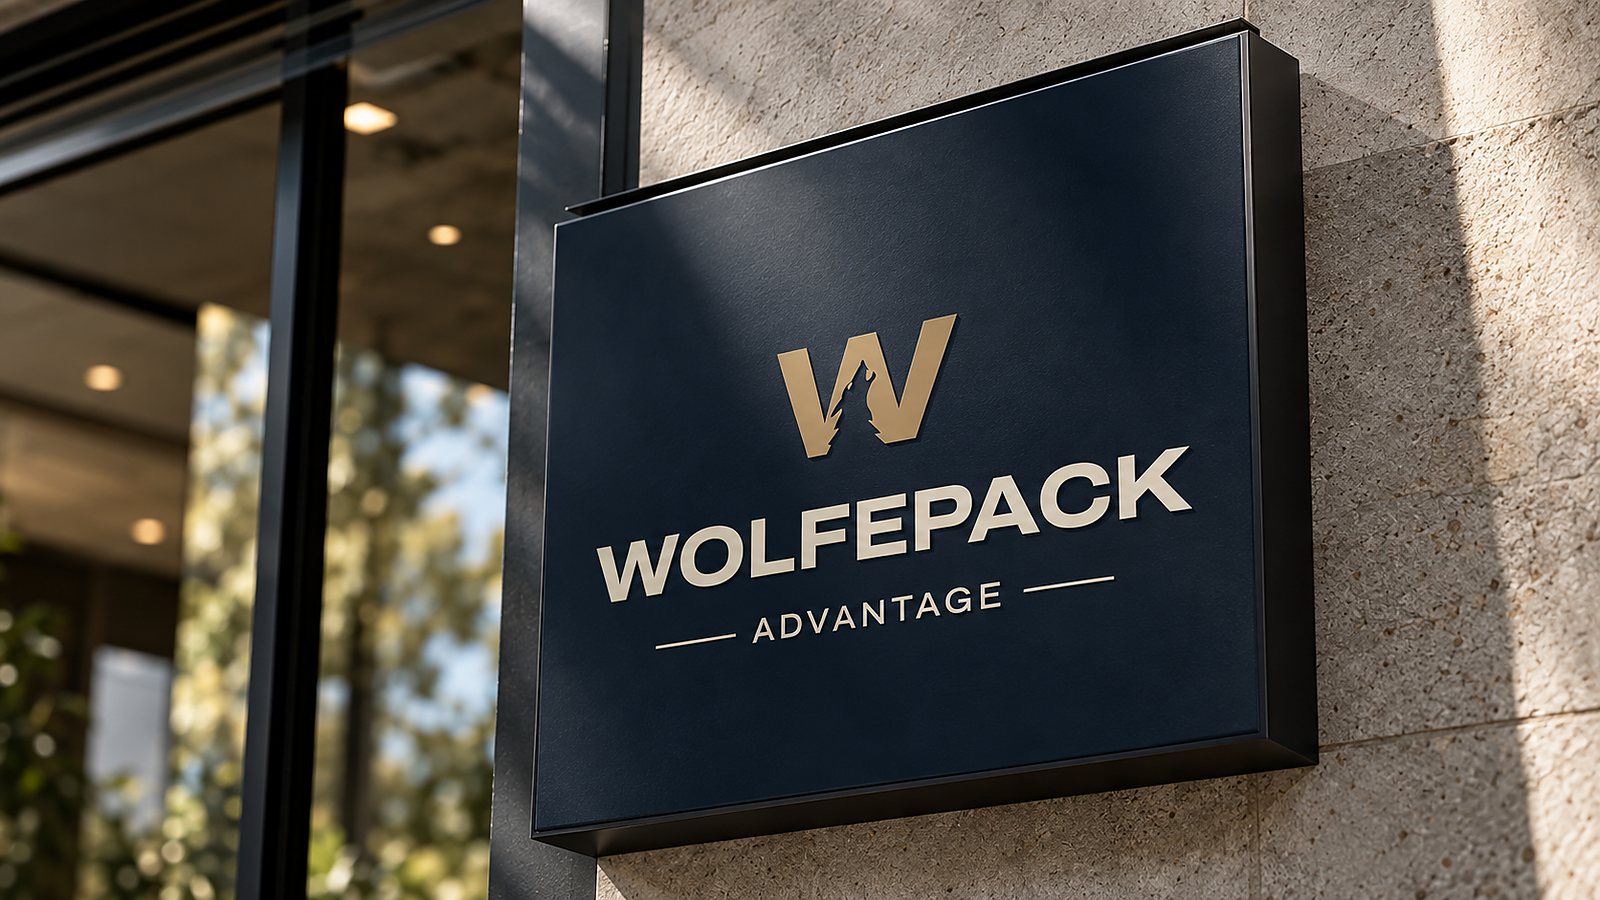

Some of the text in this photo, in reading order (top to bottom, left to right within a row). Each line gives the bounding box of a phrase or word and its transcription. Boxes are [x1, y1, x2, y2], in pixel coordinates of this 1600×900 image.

[777, 313, 958, 459] W
[596, 445, 1192, 603] WOLFEPACK
[752, 581, 1002, 644] ADVANTAGE
